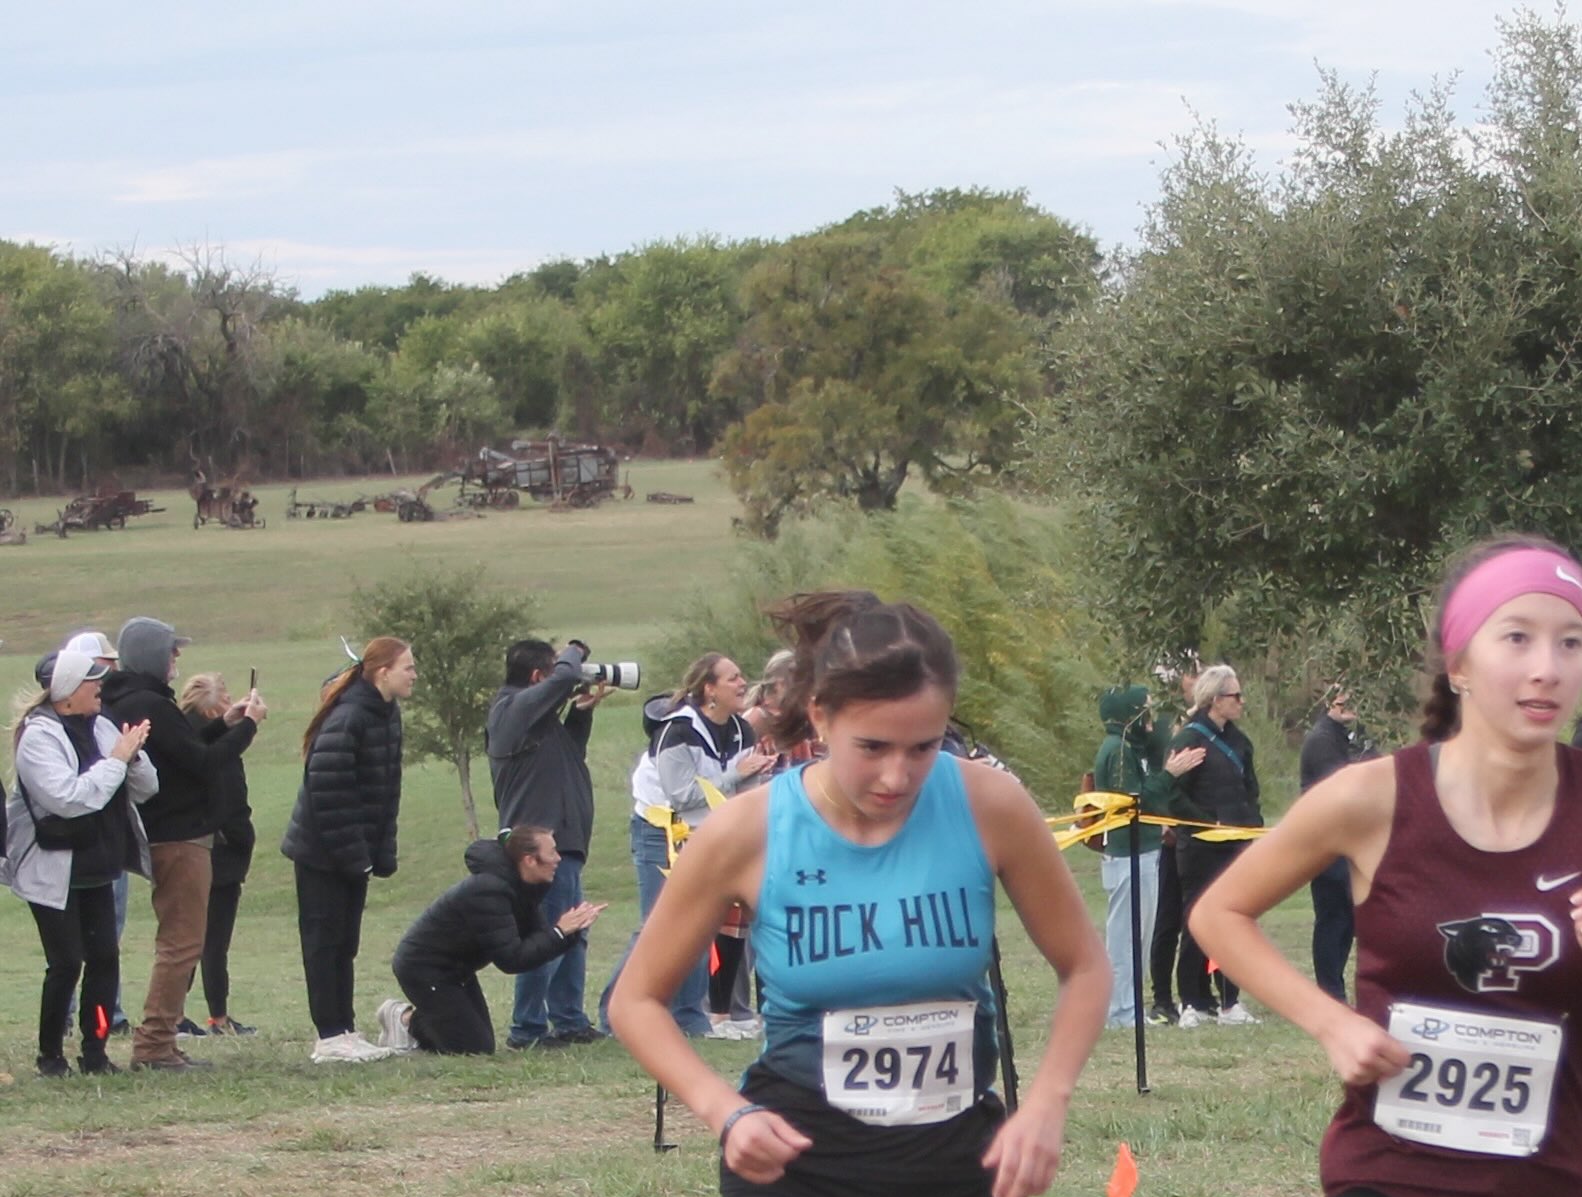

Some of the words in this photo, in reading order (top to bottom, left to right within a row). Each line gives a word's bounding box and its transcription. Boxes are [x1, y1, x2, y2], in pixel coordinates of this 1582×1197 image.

[785, 902, 884, 967] ROCK
[898, 887, 979, 949] HILL
[882, 1009, 960, 1027] COMPTON
[1453, 1023, 1543, 1045] COMPTON
[842, 1041, 960, 1091] 2974
[1399, 1052, 1534, 1115] 2925
